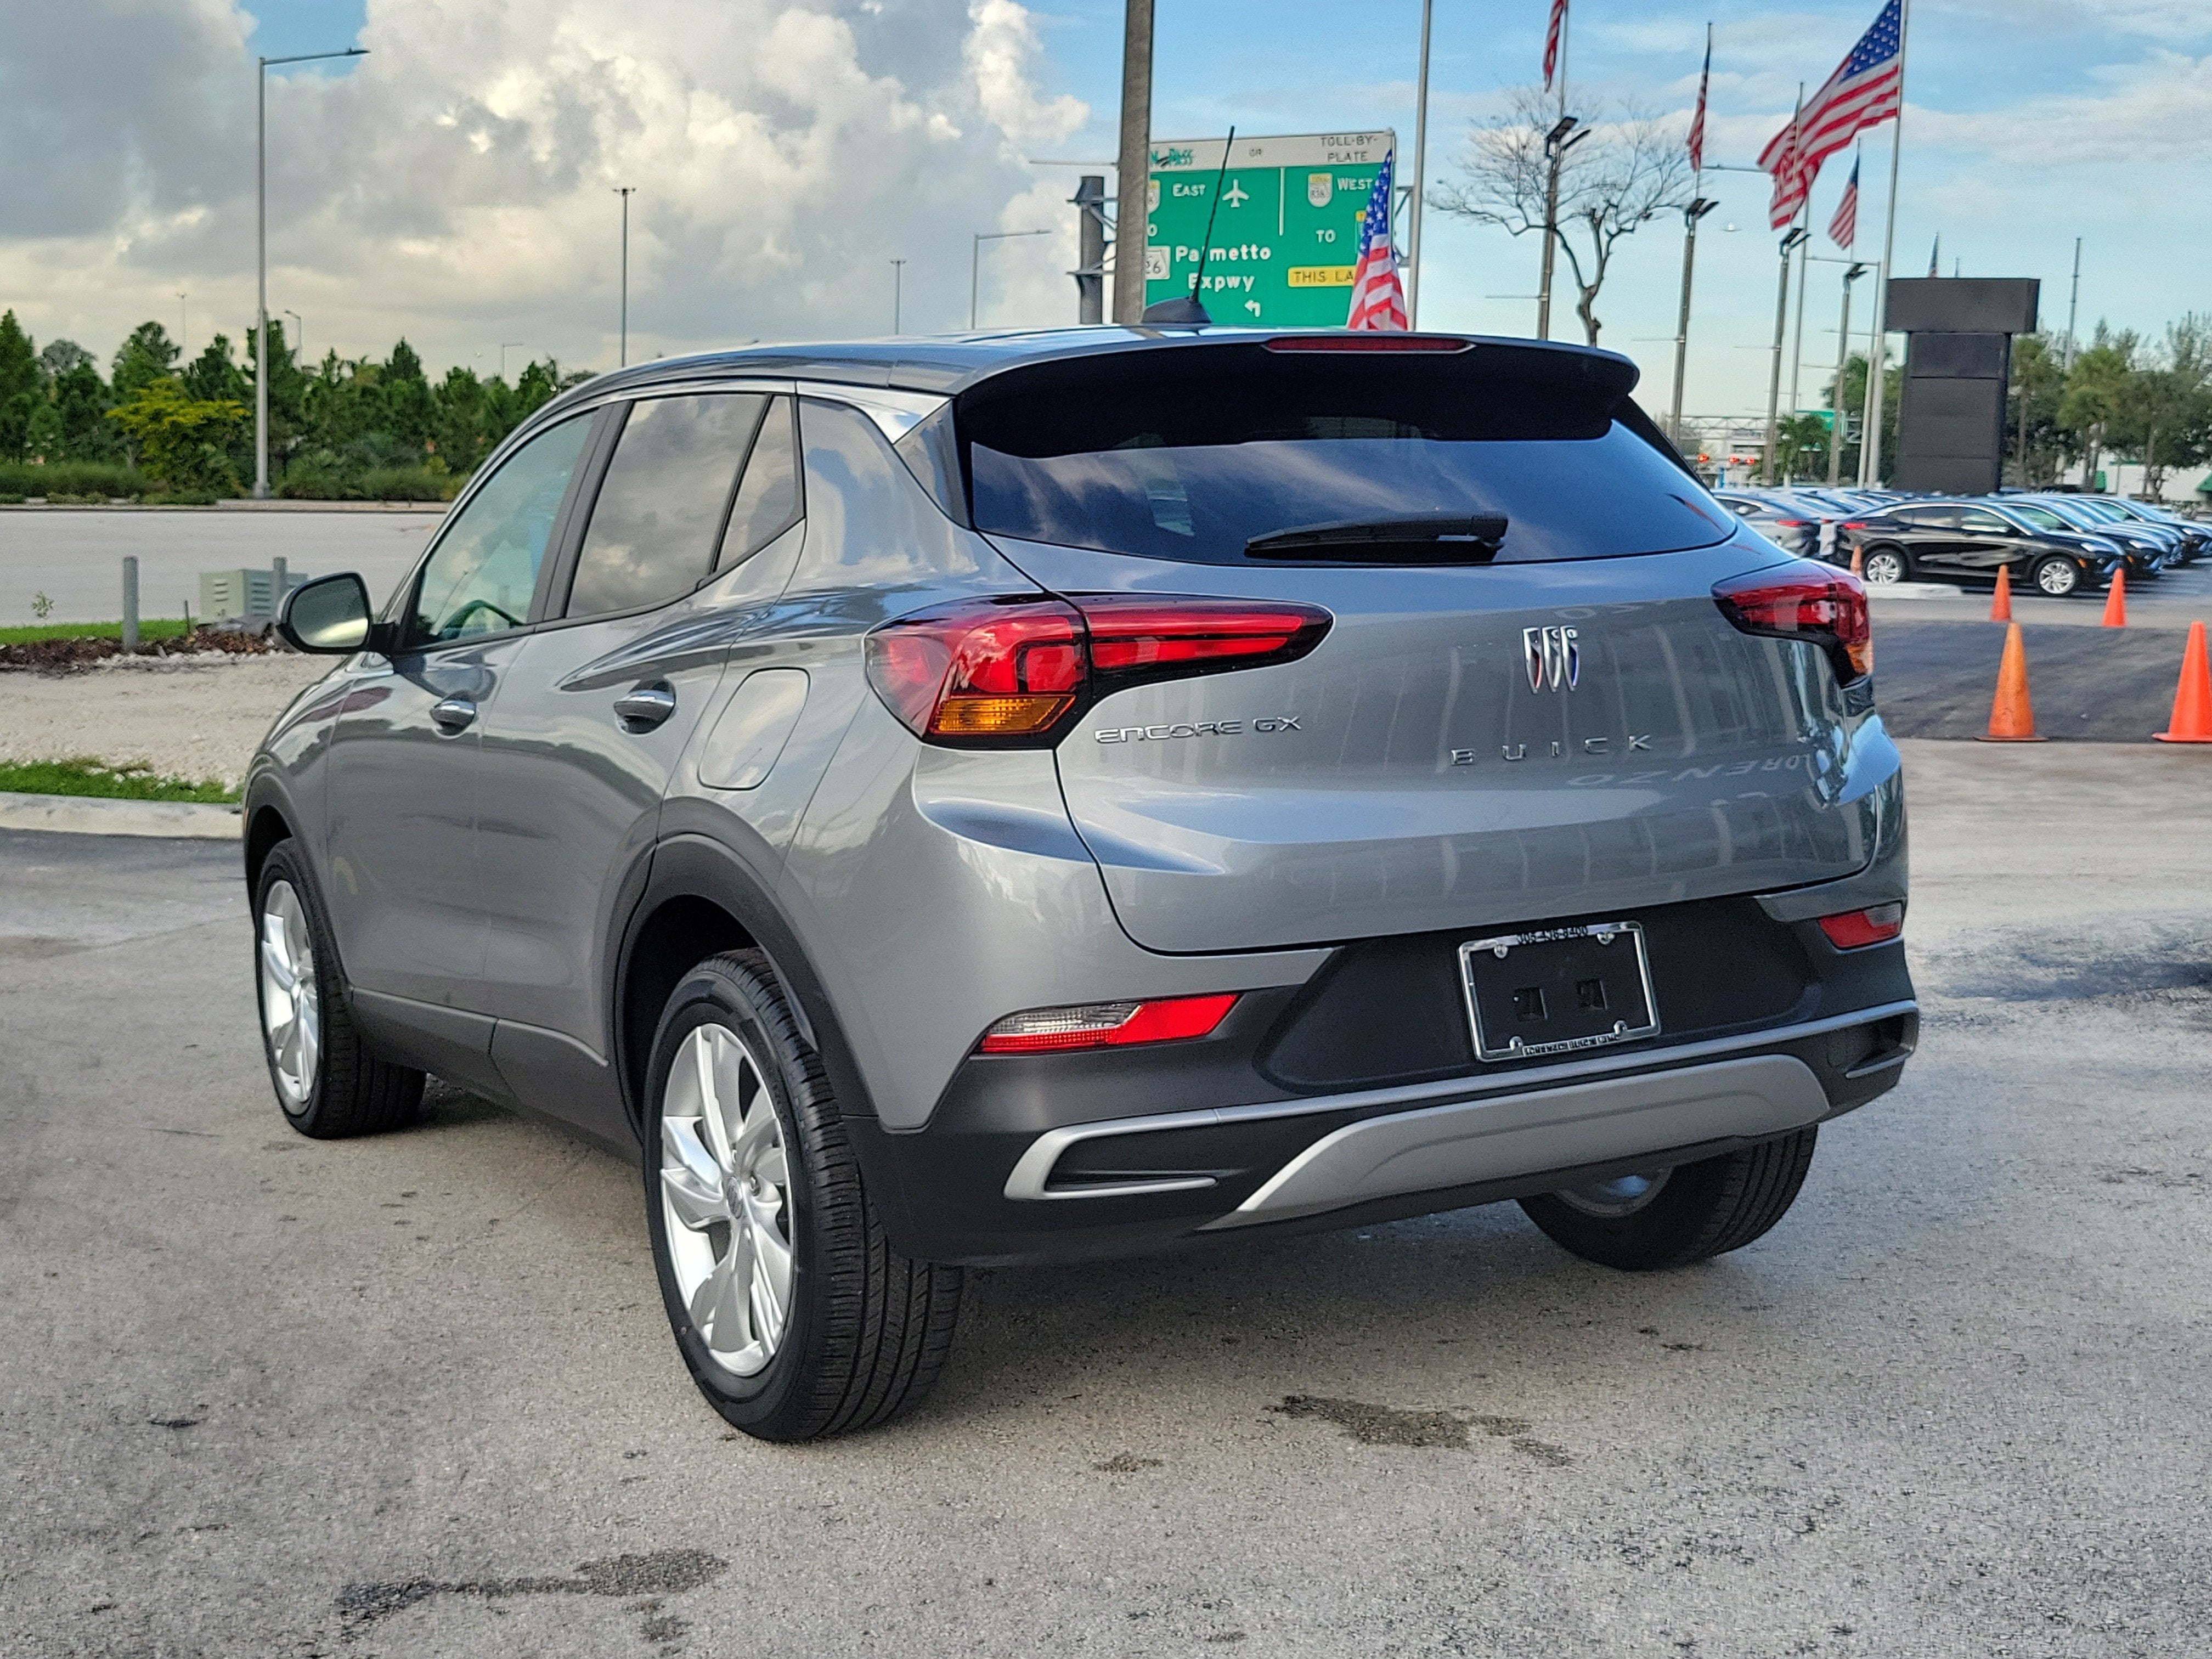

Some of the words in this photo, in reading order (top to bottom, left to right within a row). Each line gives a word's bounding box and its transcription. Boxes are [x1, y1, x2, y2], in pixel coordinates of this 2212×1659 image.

[1327, 151, 1368, 163] PLATE
[1172, 183, 1206, 197] EAST
[1337, 177, 1373, 191] WEST
[1316, 229, 1336, 243] TO
[1188, 272, 1255, 292] Expwy
[1293, 271, 1327, 284] THIS
[1335, 270, 1354, 283] LA
[1094, 720, 1243, 744] ENCORE
[1252, 715, 1302, 733] GX
[1450, 734, 1653, 766] BUICK
